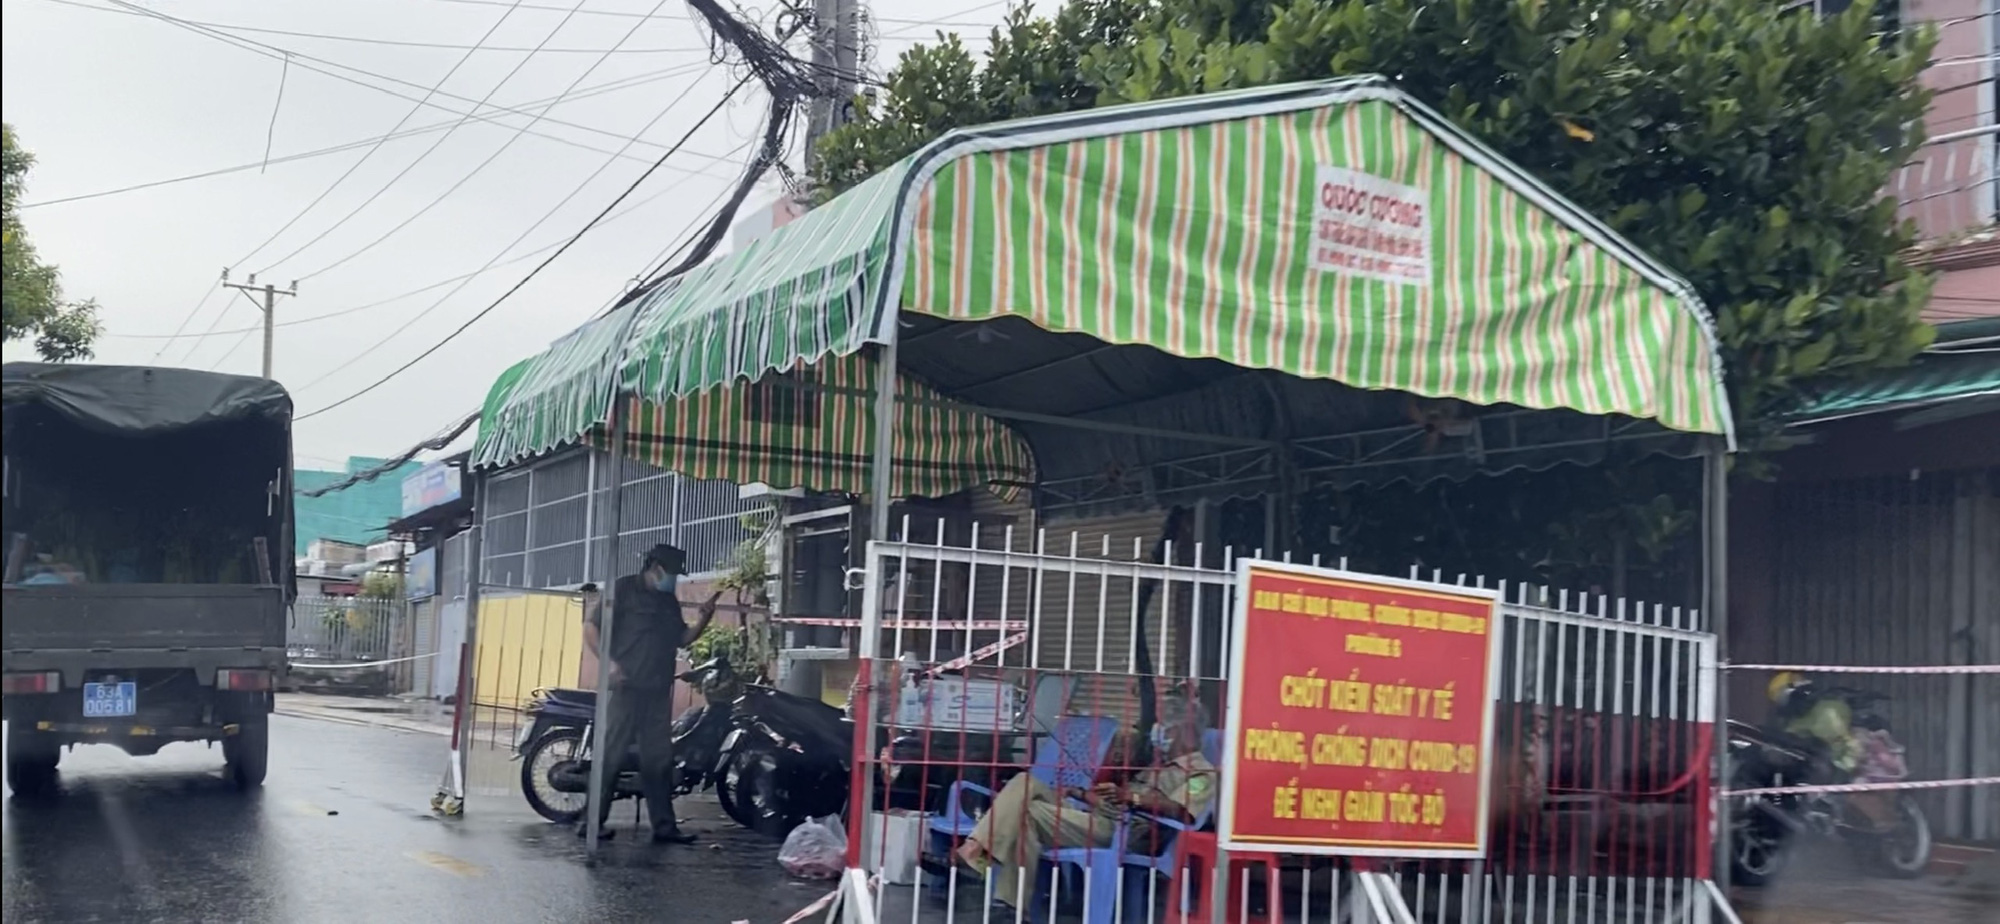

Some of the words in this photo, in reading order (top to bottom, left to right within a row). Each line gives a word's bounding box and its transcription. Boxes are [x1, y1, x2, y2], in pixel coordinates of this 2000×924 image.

[97, 685, 122, 699] 63A
[1280, 667, 1327, 709] CHỐT
[1329, 667, 1371, 713] KIỂM
[1373, 678, 1415, 717] SOÁT
[1416, 688, 1431, 718] Y
[1433, 680, 1456, 720] TẾ
[1312, 725, 1368, 766] CHỐNG
[1389, 783, 1420, 824] TỐC
